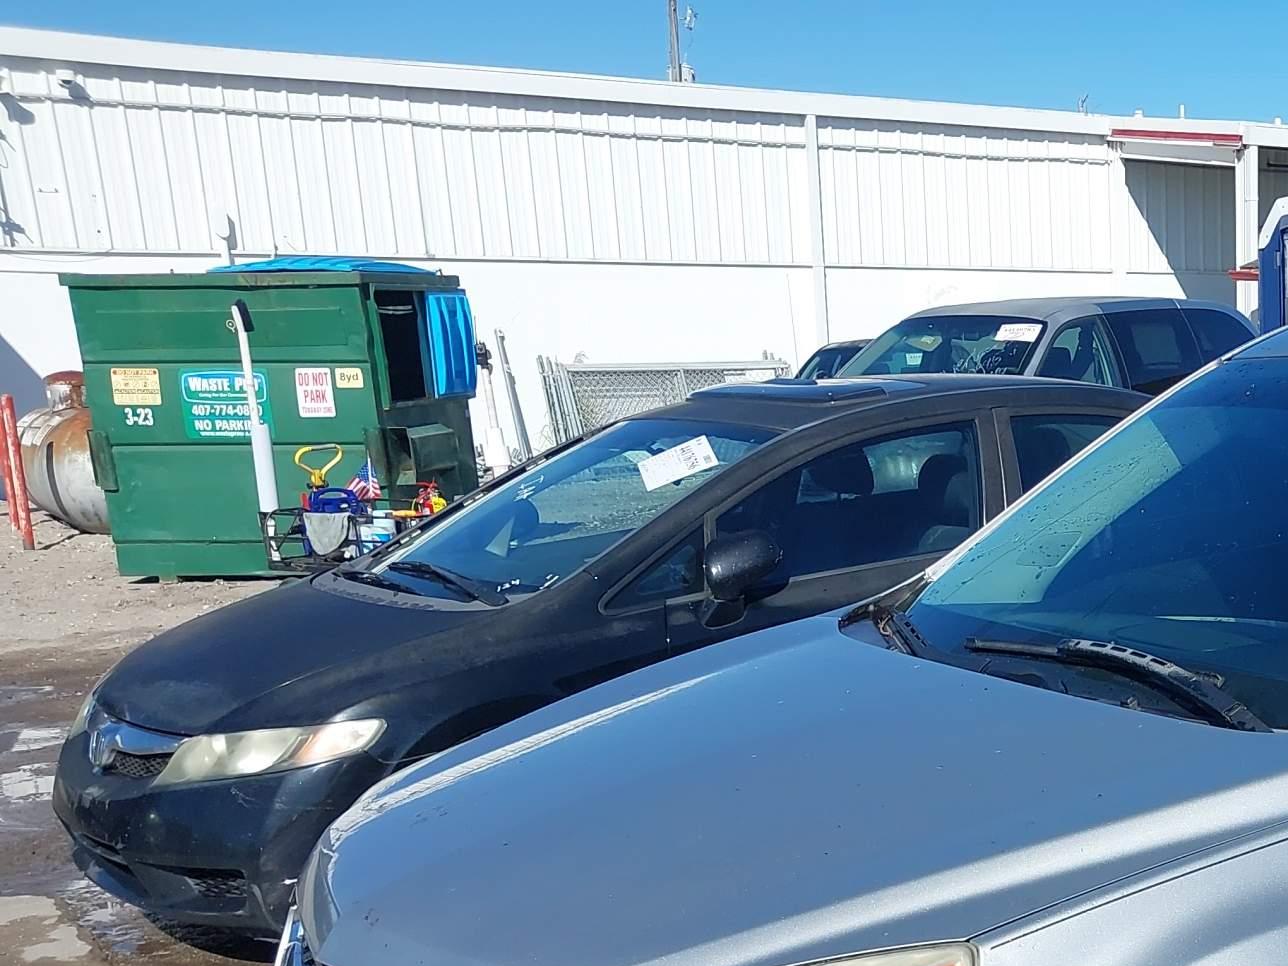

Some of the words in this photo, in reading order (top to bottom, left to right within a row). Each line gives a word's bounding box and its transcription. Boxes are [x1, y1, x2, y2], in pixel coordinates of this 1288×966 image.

[187, 376, 230, 392] WASTE
[298, 372, 309, 386] DO
[312, 372, 328, 386] NOT
[340, 372, 359, 384] Byd
[304, 389, 328, 404] PARK
[124, 407, 154, 426] 3-23
[192, 404, 263, 417] 407-774-080
[194, 419, 213, 431] NO
